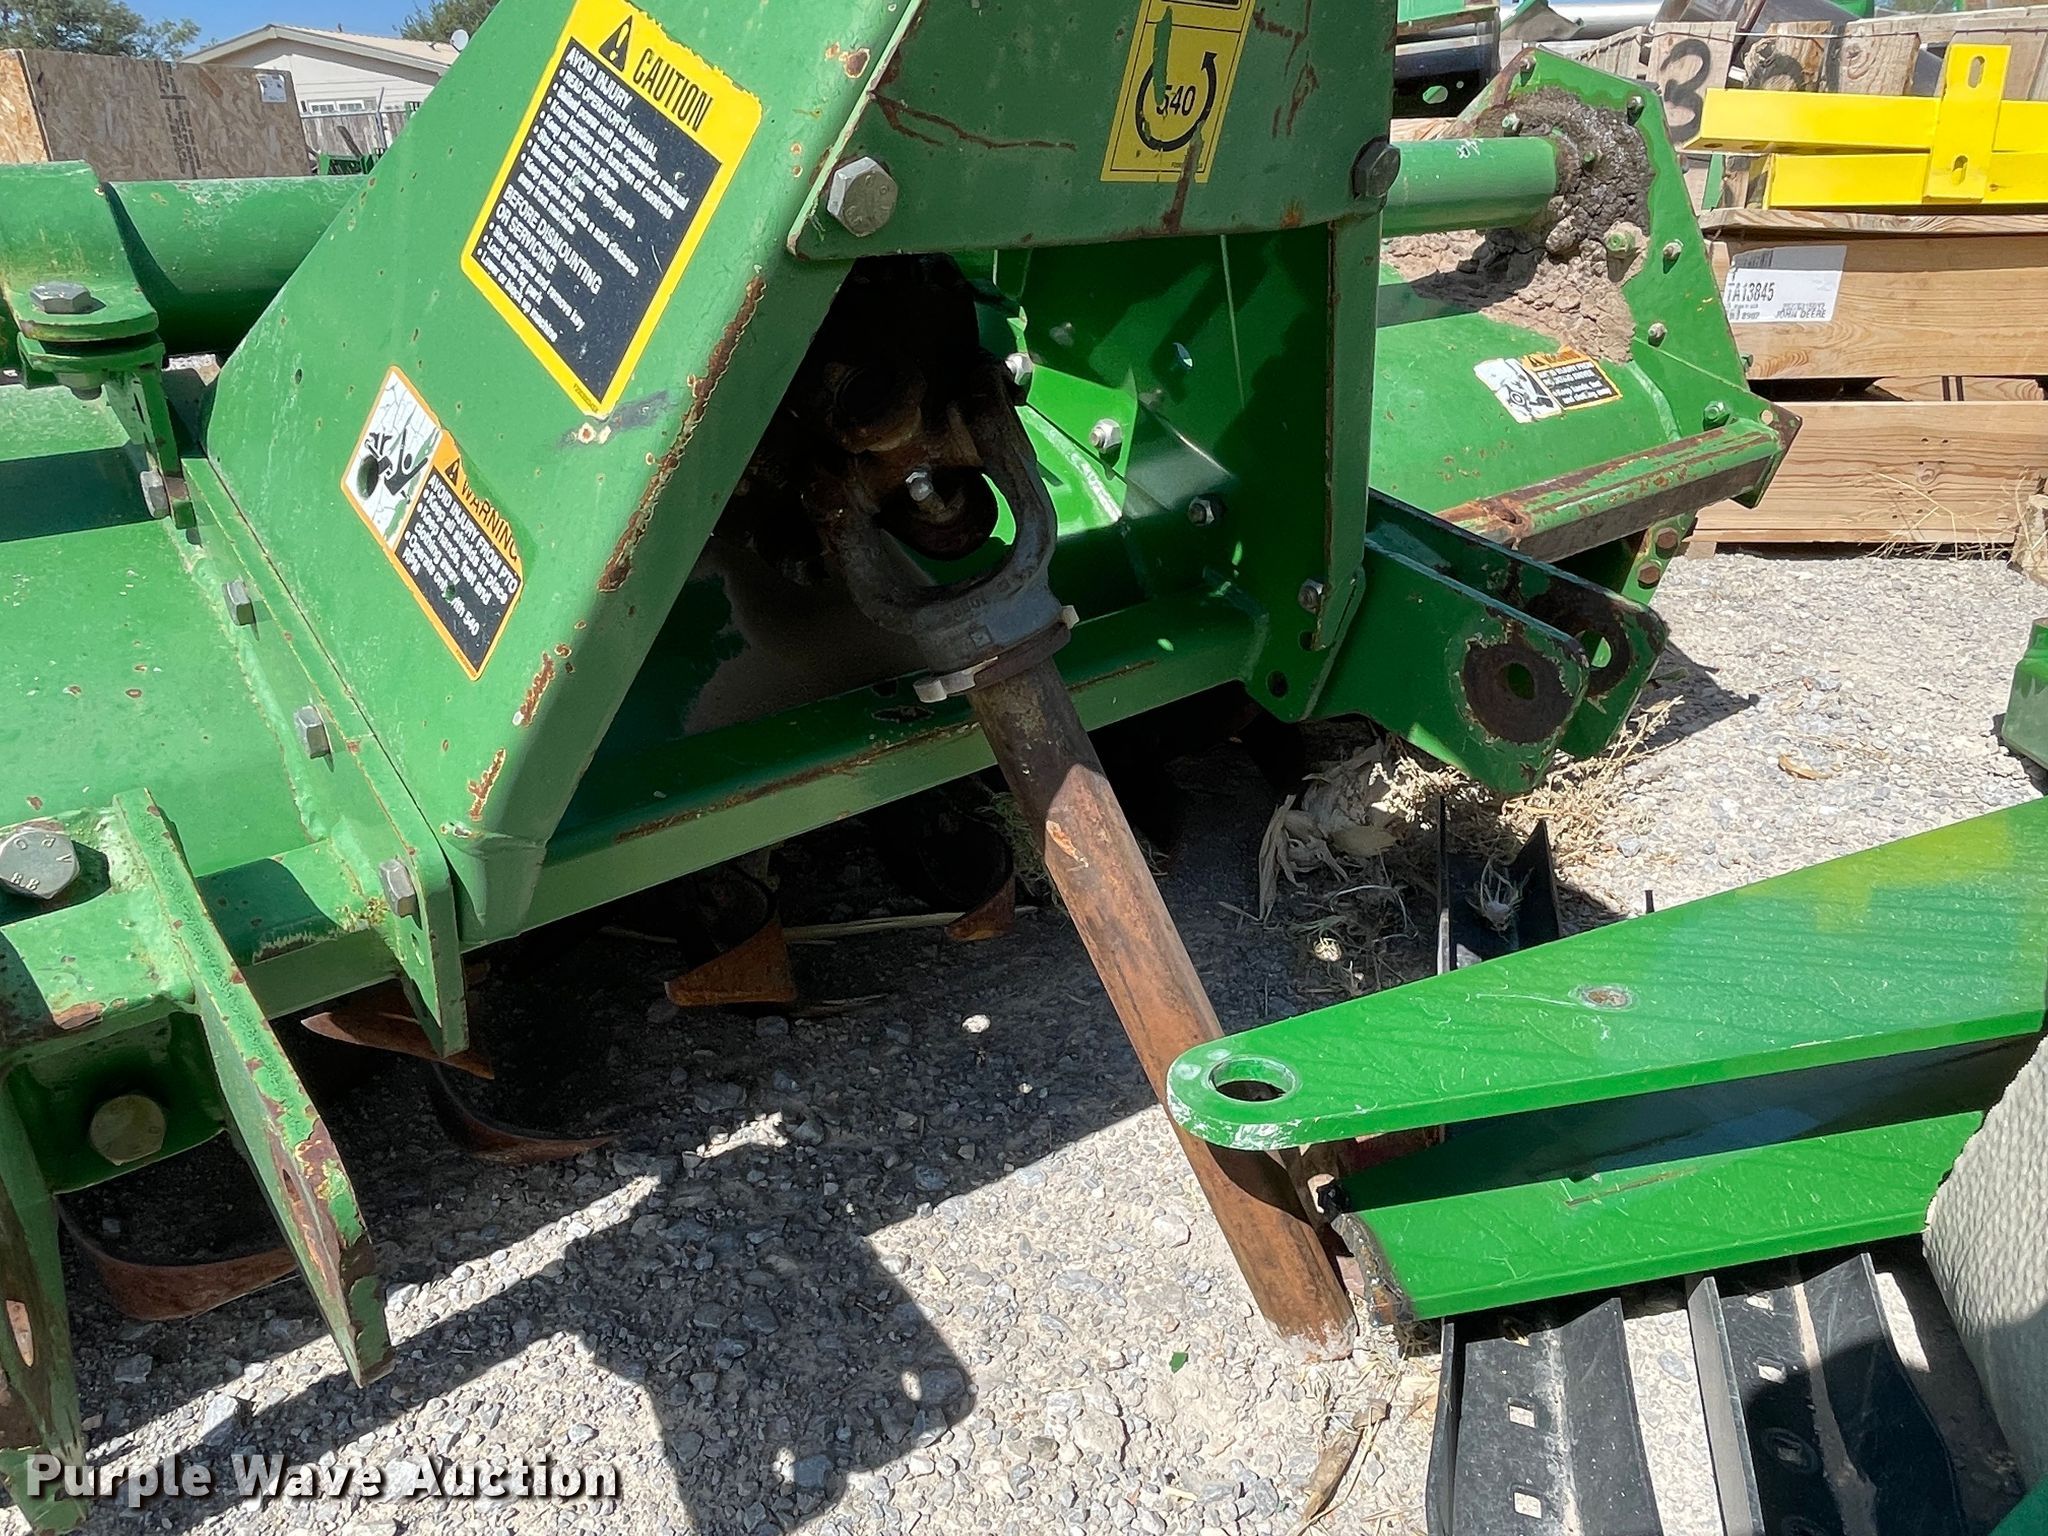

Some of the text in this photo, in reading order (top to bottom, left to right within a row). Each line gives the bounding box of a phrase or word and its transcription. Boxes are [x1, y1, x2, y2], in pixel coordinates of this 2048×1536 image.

[562, 69, 584, 94] READ
[624, 124, 657, 162] MANUAL
[565, 46, 632, 110] AVOID INJURY
[632, 47, 713, 132] CAUTION
[530, 141, 550, 167] Never
[547, 161, 566, 184] carry
[536, 127, 635, 229] Stay clear of power driven parts
[542, 113, 618, 191] Keep all shields in place
[549, 98, 673, 219] Know location and function of controls
[575, 105, 600, 130] power
[597, 123, 614, 143] unit
[609, 136, 626, 153] per
[658, 179, 689, 210] manual
[495, 202, 556, 274] OR SERVICING
[502, 183, 602, 294] BEFORE DISMOUNTING
[517, 172, 575, 234] away from machine
[523, 155, 638, 277] Keep people and pets a safe distance
[480, 250, 500, 276] Lower
[497, 272, 507, 284] or
[504, 277, 523, 303] block
[529, 307, 557, 342] machine
[486, 237, 503, 260] Lock
[500, 252, 519, 278] brake
[524, 283, 543, 309] park
[505, 241, 518, 255] off
[514, 249, 536, 277] engine
[534, 272, 550, 291] and
[546, 285, 572, 316] remove
[569, 308, 585, 331] key
[401, 546, 421, 575] RPM
[412, 522, 460, 585] clothing away
[420, 505, 492, 605] Keep hands, feet and
[424, 491, 508, 604] Keep all shields in place
[427, 474, 518, 593] AVOID INJURY FROM PTO
[407, 533, 437, 575] Operate
[462, 610, 479, 635] 540
